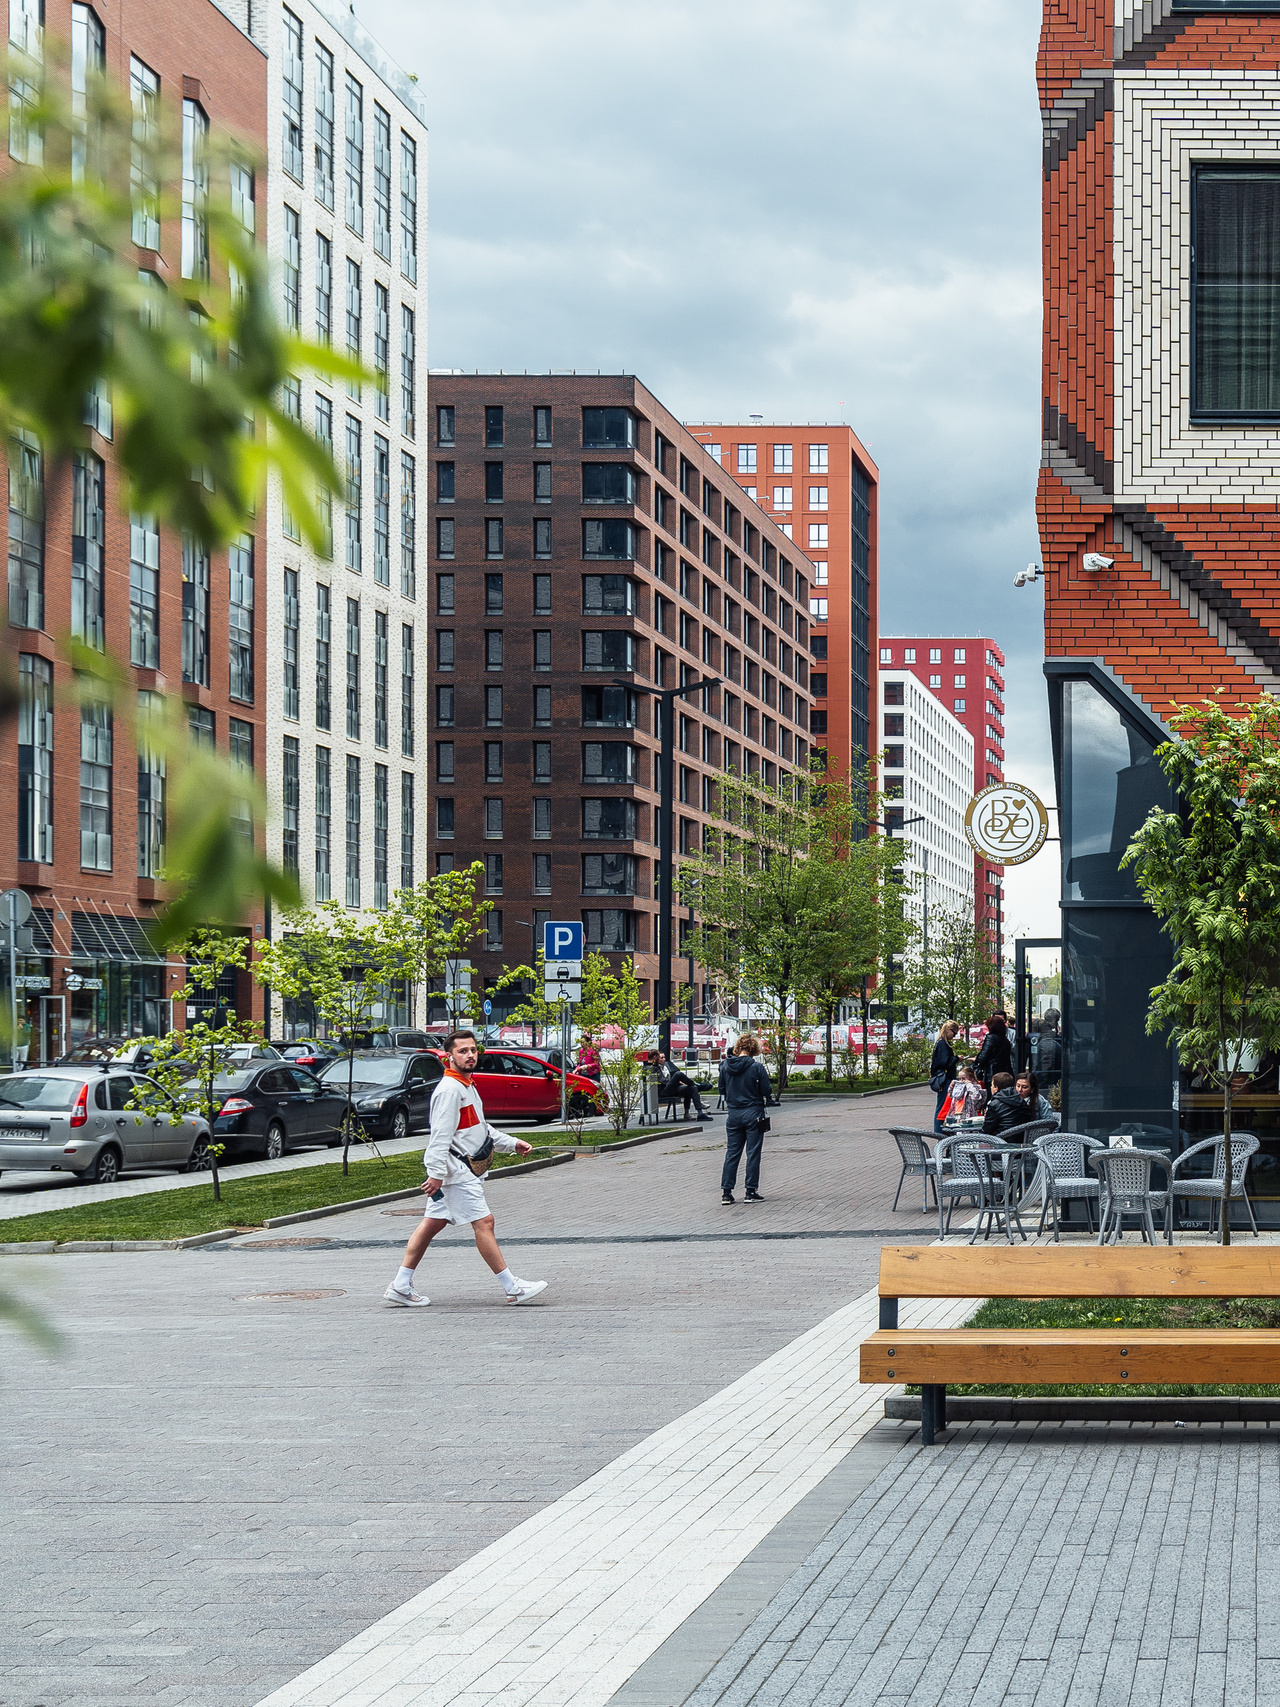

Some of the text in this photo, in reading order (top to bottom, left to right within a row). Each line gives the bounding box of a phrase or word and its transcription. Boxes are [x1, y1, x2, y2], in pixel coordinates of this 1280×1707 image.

[974, 783, 1038, 803] ЗАВТРАКИ ВЕСЬ ДЕНЬ
[965, 825, 982, 853] ДЕСЕРТЫ
[986, 854, 1006, 864] КОФЕ
[1011, 850, 1033, 863] ТОРТЫ
[554, 927, 573, 956] P
